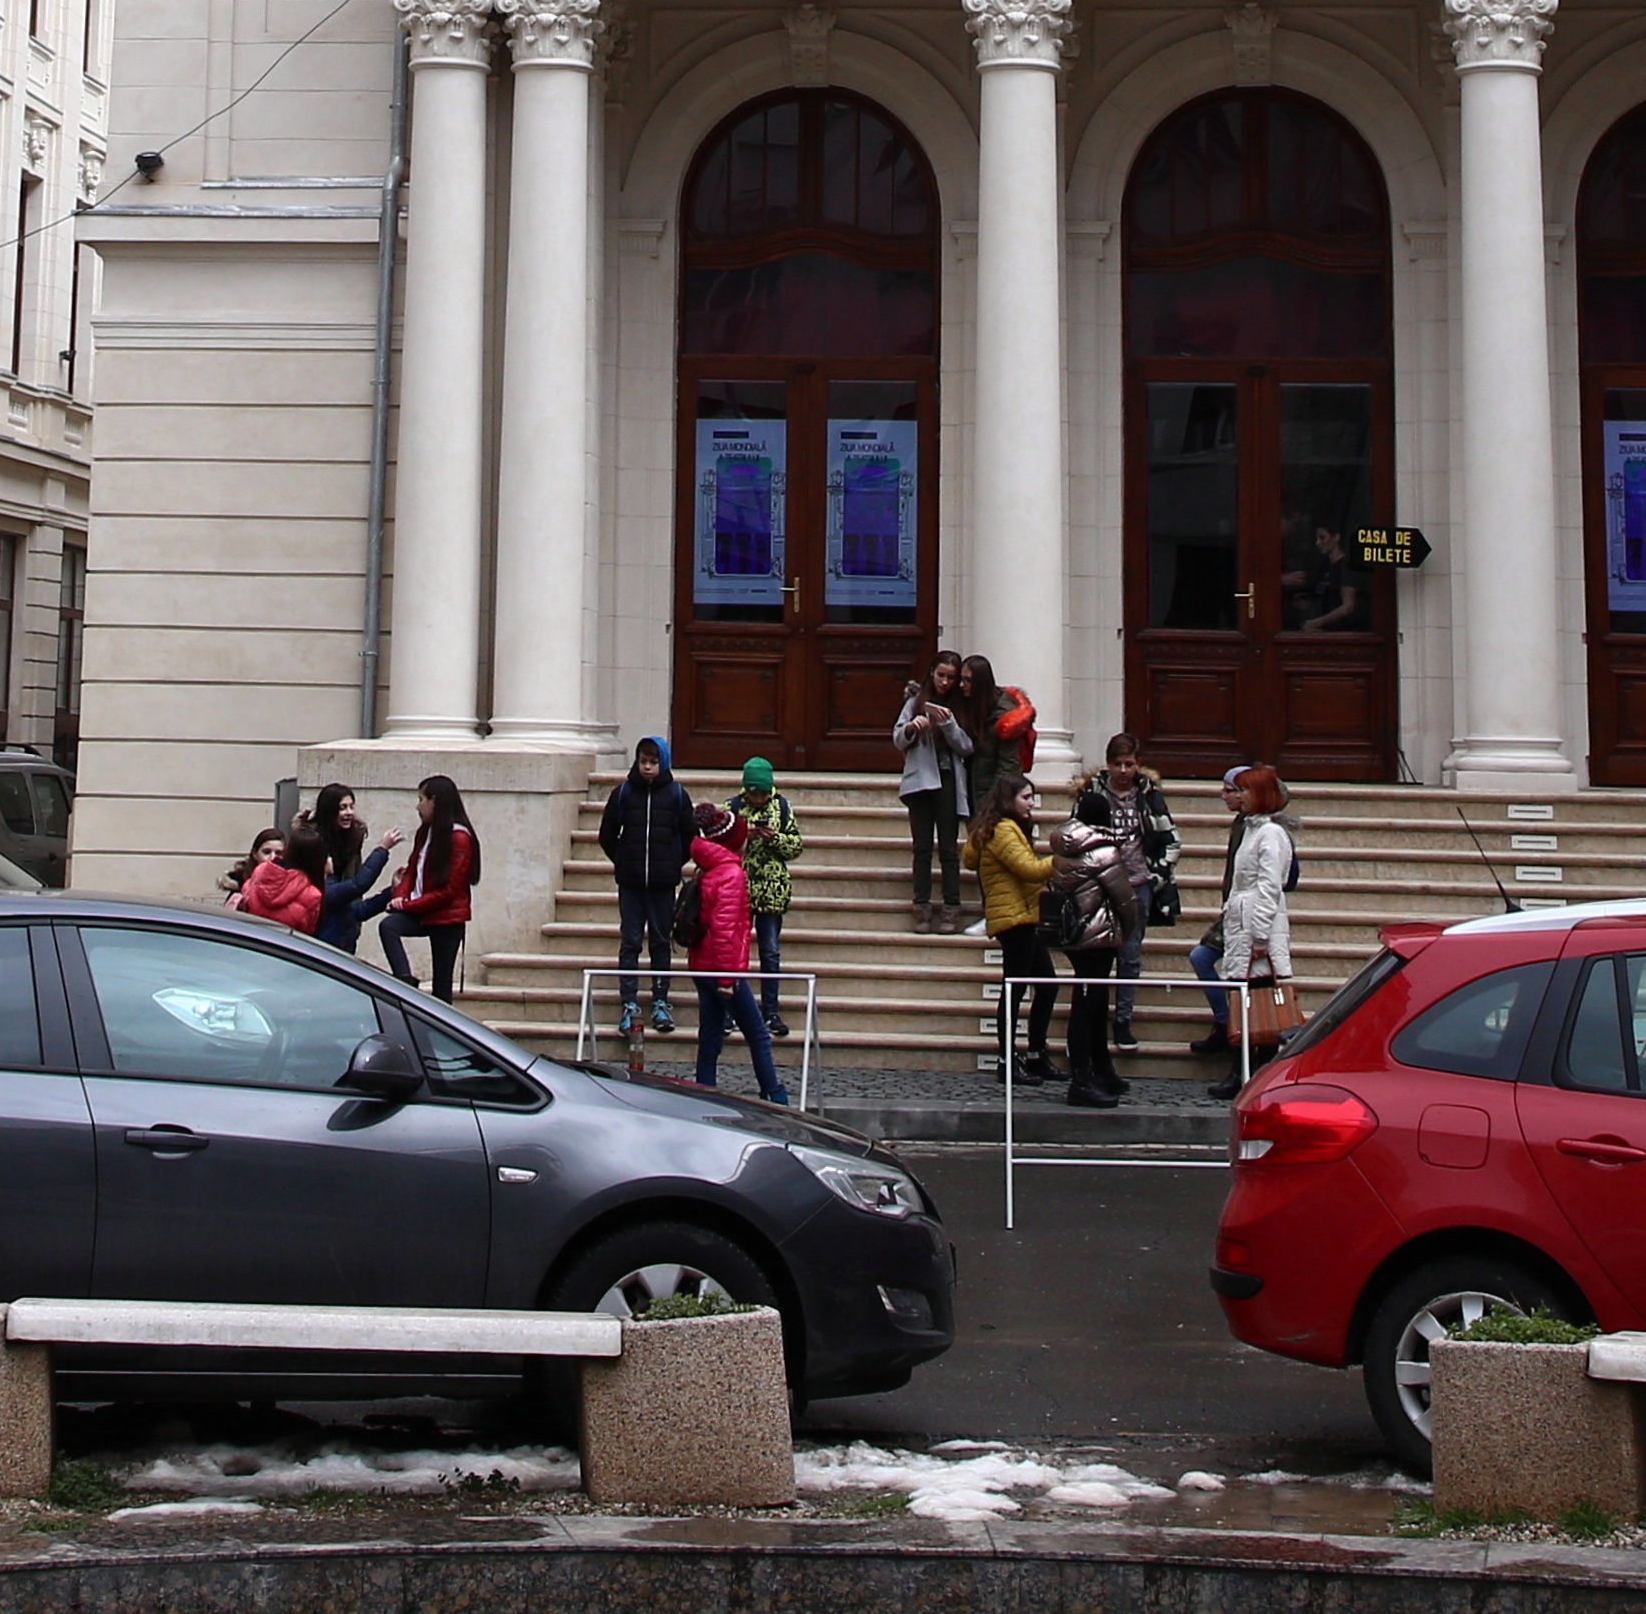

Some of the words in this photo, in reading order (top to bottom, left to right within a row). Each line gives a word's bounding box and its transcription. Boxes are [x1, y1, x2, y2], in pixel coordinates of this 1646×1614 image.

[1358, 529, 1388, 545] CASA
[1395, 531, 1411, 546] DE
[1364, 547, 1411, 564] BILETE
